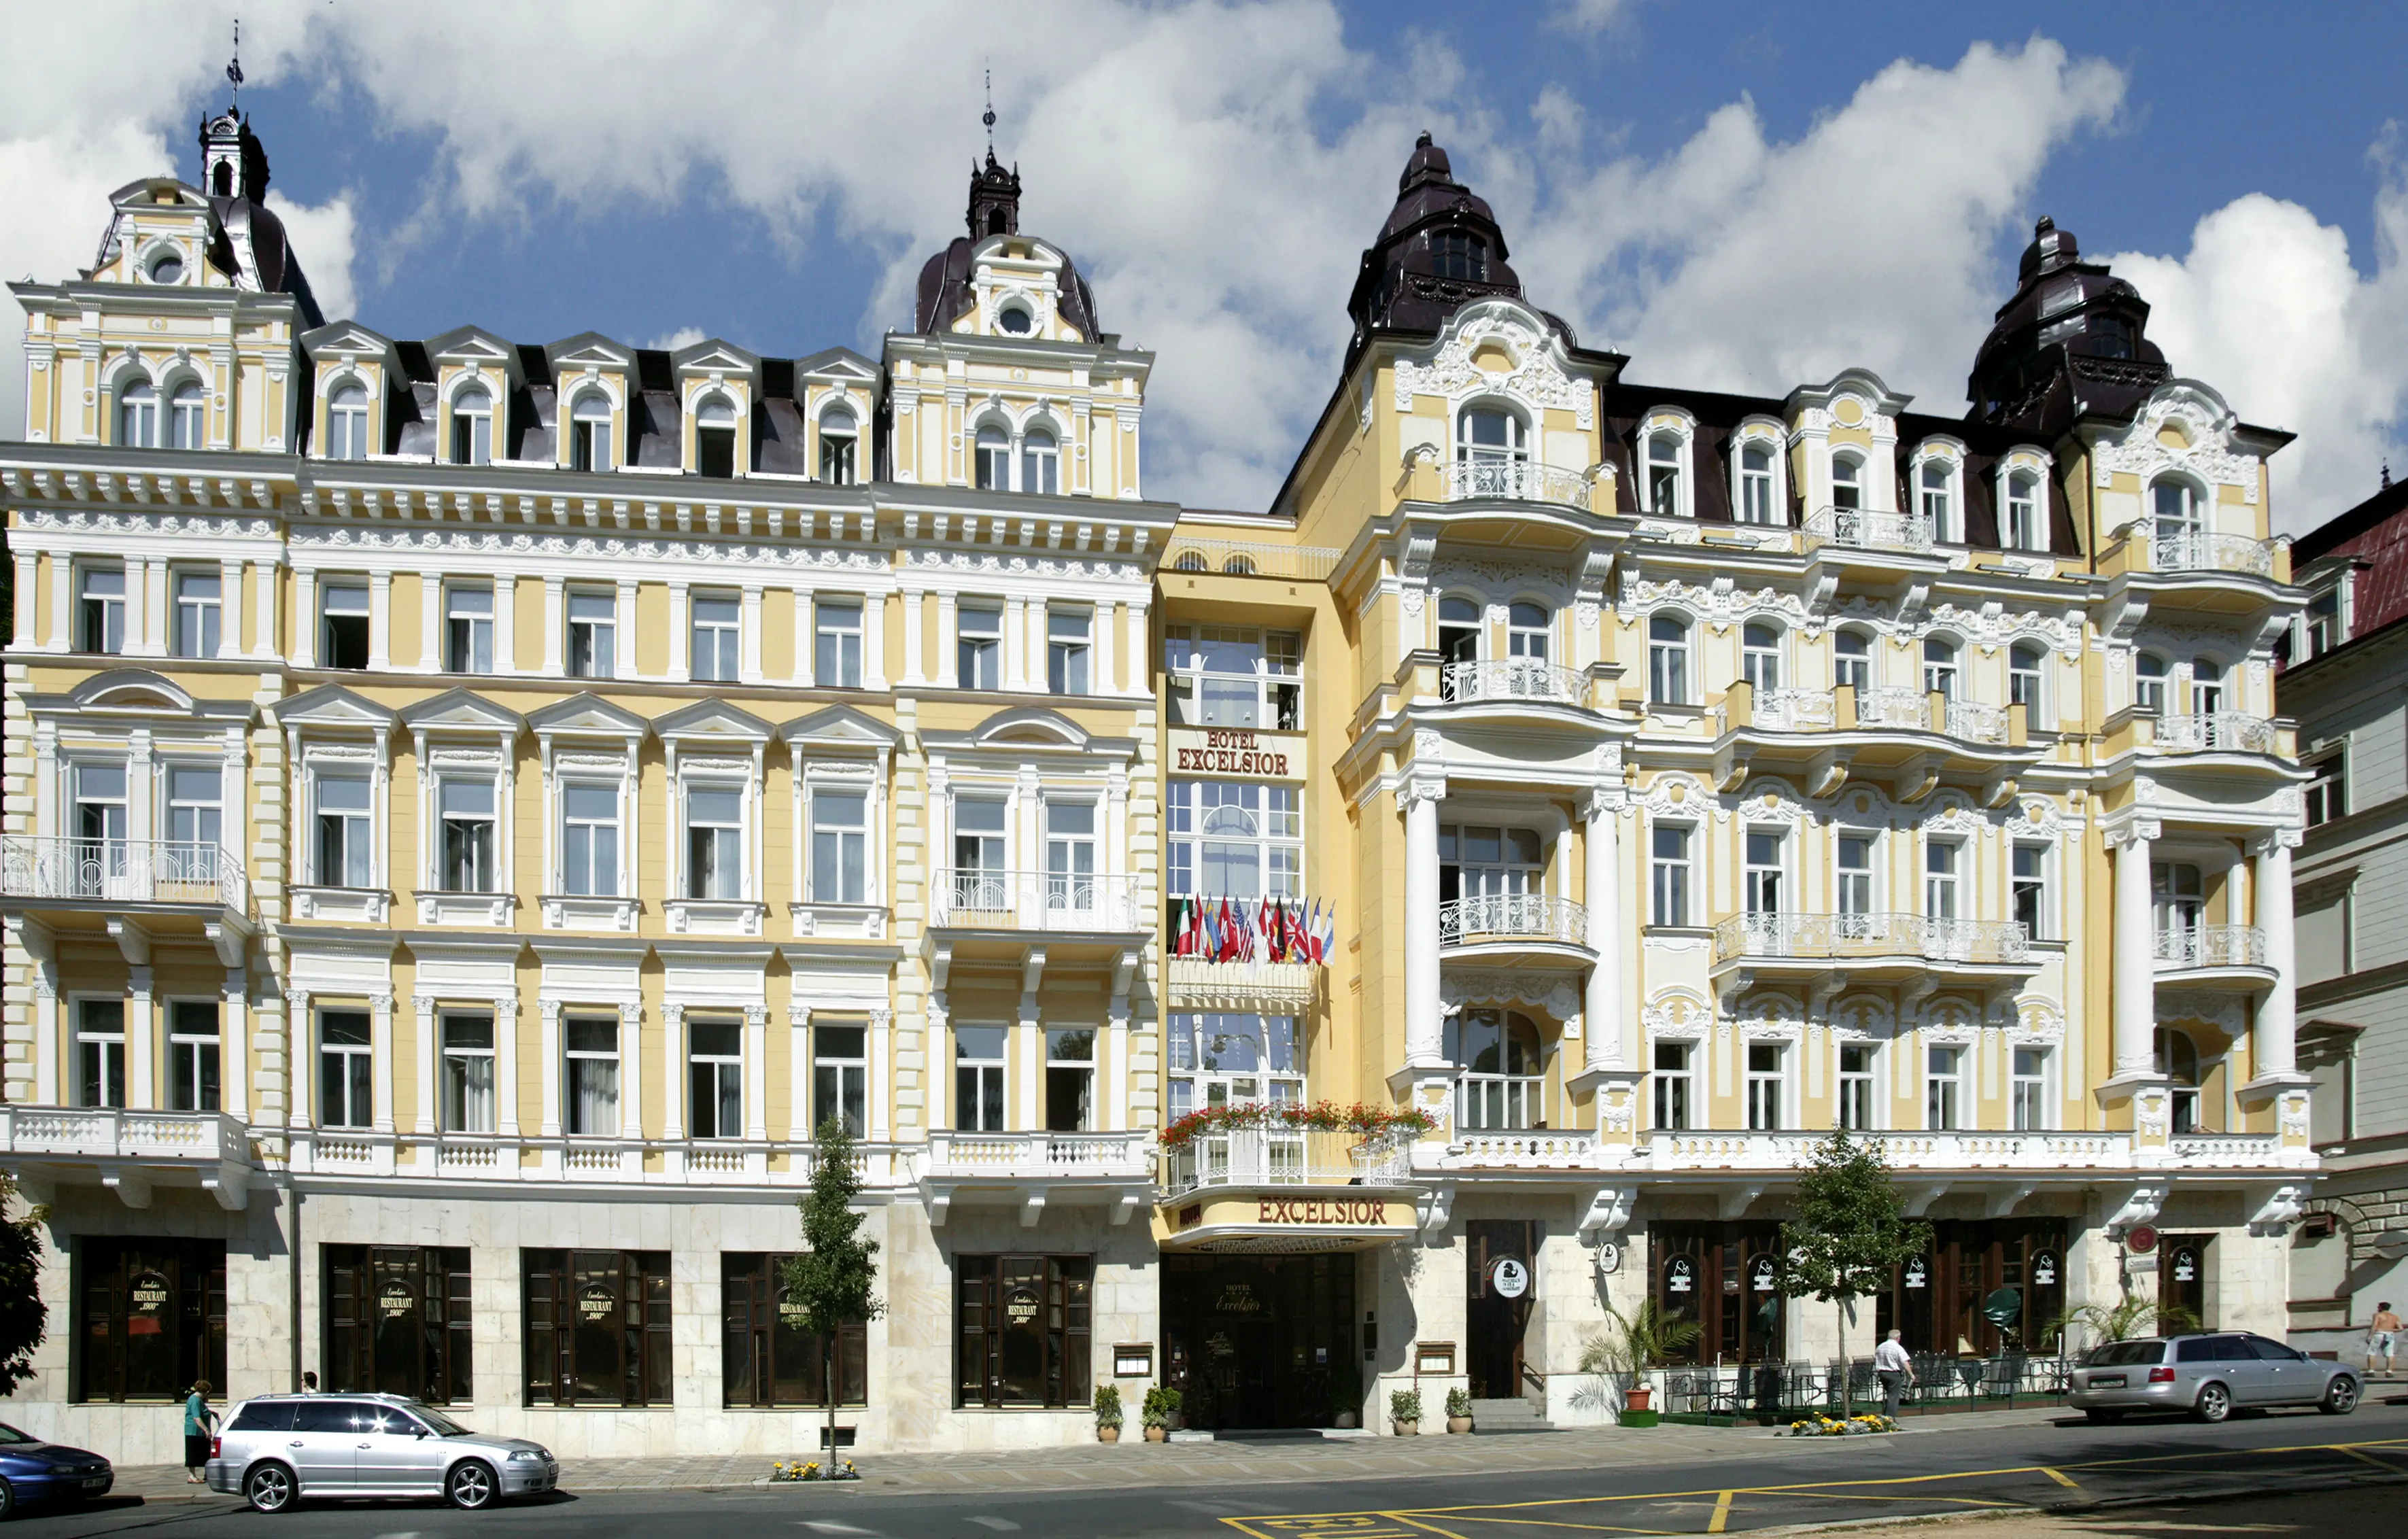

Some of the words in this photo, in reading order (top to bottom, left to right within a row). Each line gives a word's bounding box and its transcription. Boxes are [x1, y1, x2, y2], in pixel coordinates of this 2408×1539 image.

[1207, 730, 1258, 750] HOTEL
[1177, 748, 1288, 776] EXCELSIOR
[1258, 1197, 1387, 1224] EXCELSIOR
[133, 1291, 167, 1302] RESTAURANT
[381, 1298, 413, 1308] RESTAURANT
[581, 1301, 612, 1311] RESTAURANT
[1008, 1305, 1037, 1315] RESTAURANT
